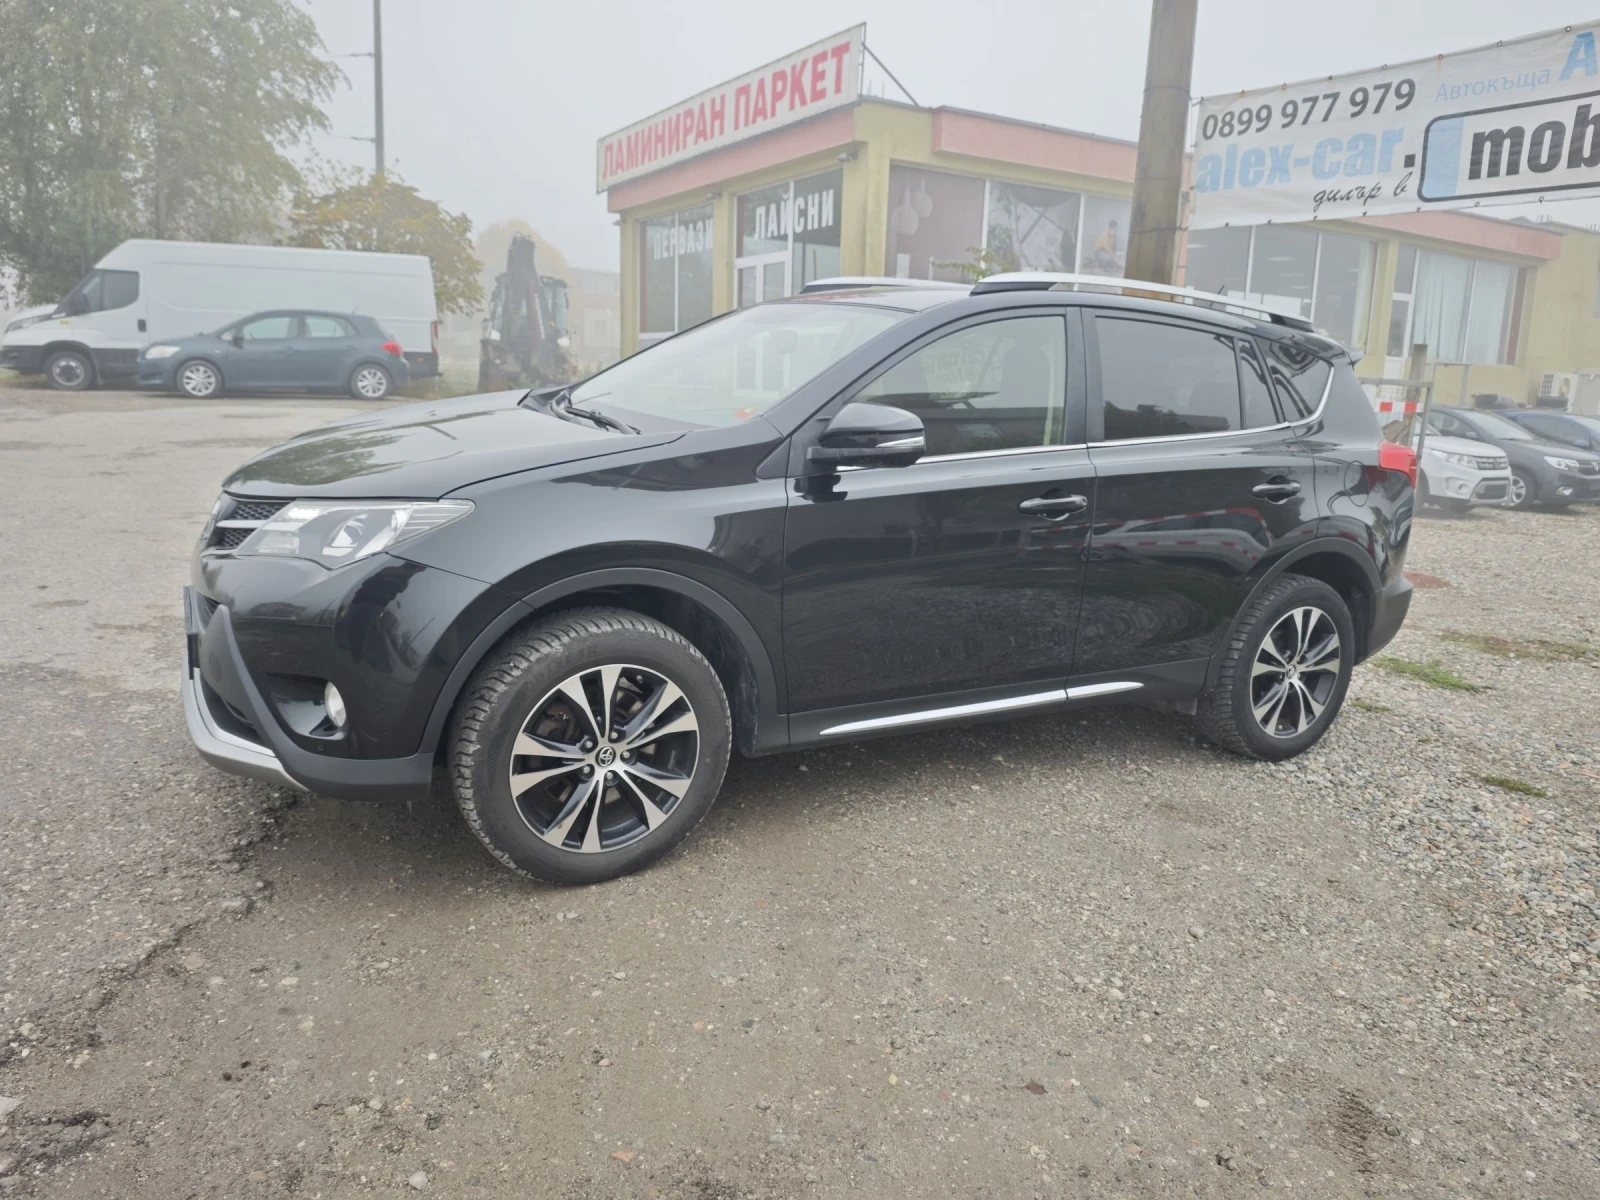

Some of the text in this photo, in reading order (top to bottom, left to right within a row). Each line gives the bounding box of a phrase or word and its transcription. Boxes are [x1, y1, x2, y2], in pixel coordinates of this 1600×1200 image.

[602, 40, 851, 181] ЛАМИНИРАН ПАРКЕТ
[1202, 78, 1416, 141] 0899 977 979
[1434, 68, 1550, 102] Автокъща
[753, 188, 834, 240] ЛАЙСНИ
[1313, 181, 1382, 212] дилър
